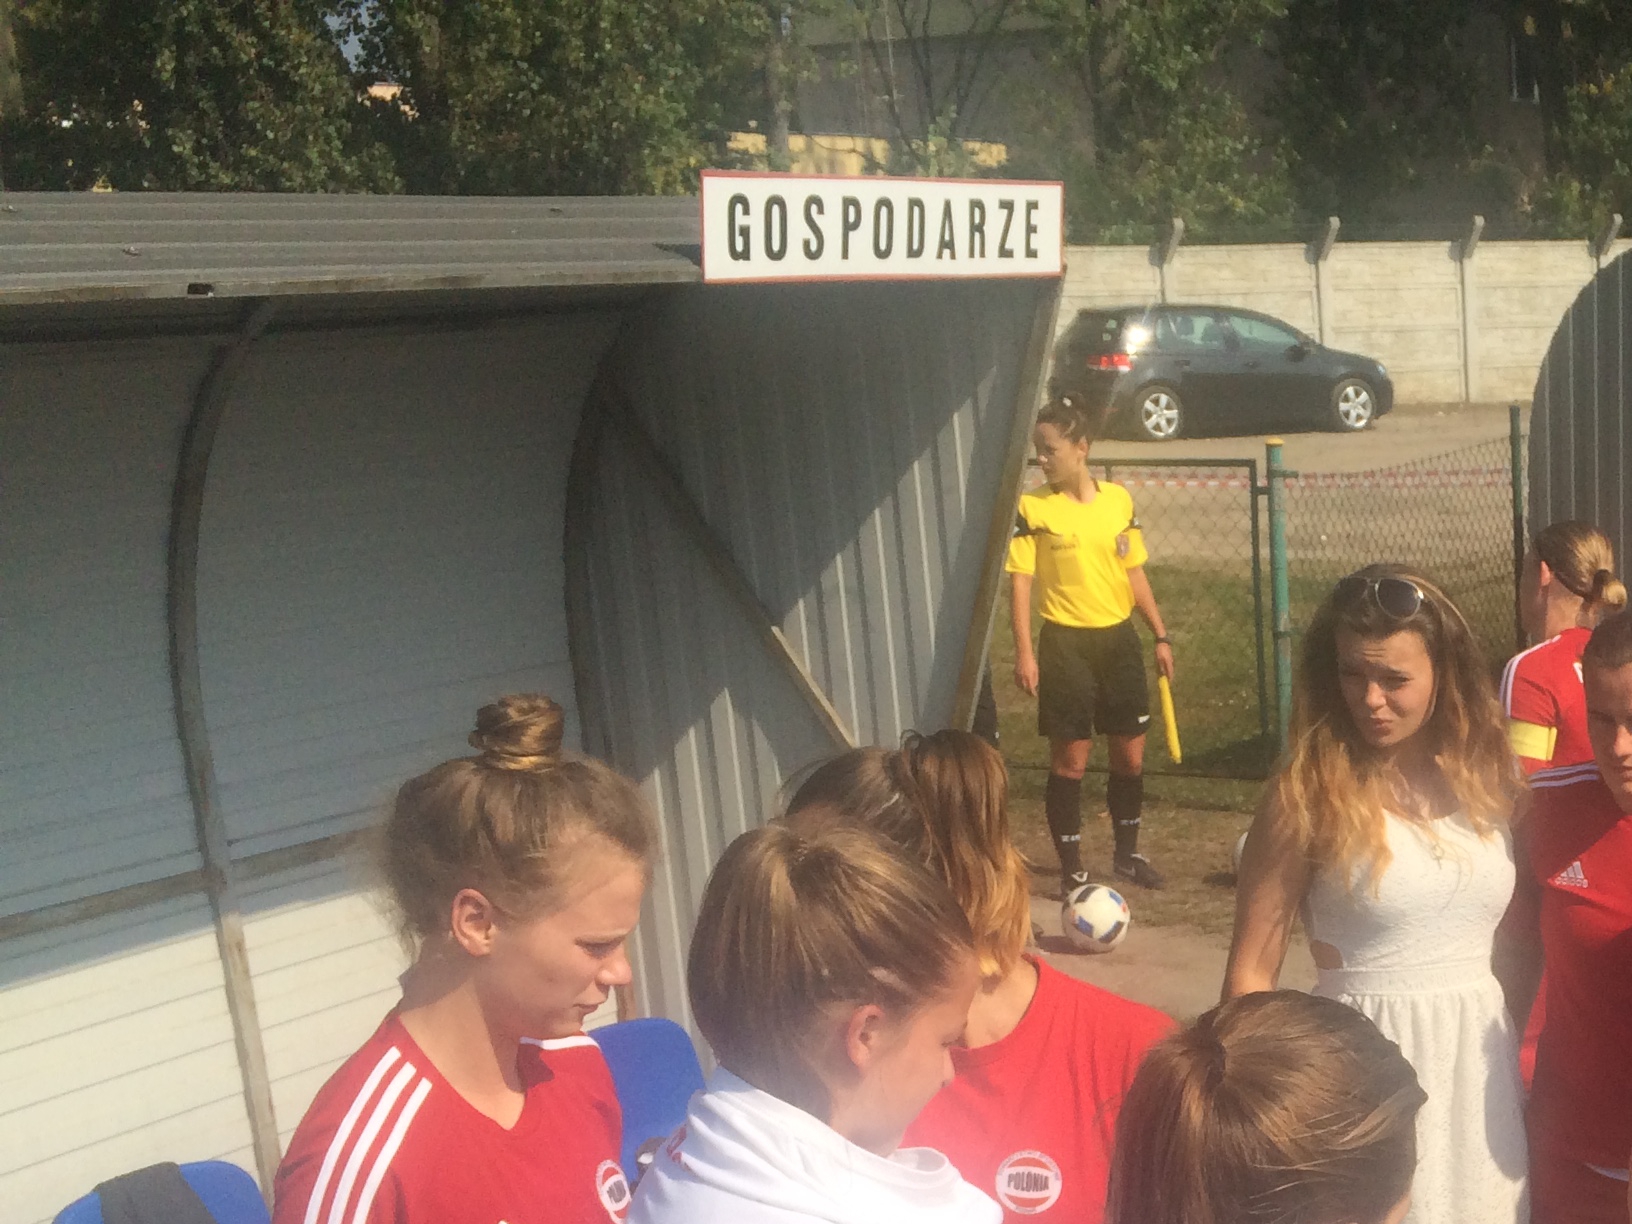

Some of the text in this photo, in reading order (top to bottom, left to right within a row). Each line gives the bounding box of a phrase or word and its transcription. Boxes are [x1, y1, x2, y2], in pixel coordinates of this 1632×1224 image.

[728, 193, 1039, 261] GOSPODARZE
[1554, 876, 1589, 889] adidas
[1007, 1171, 1050, 1193] POLONIA
